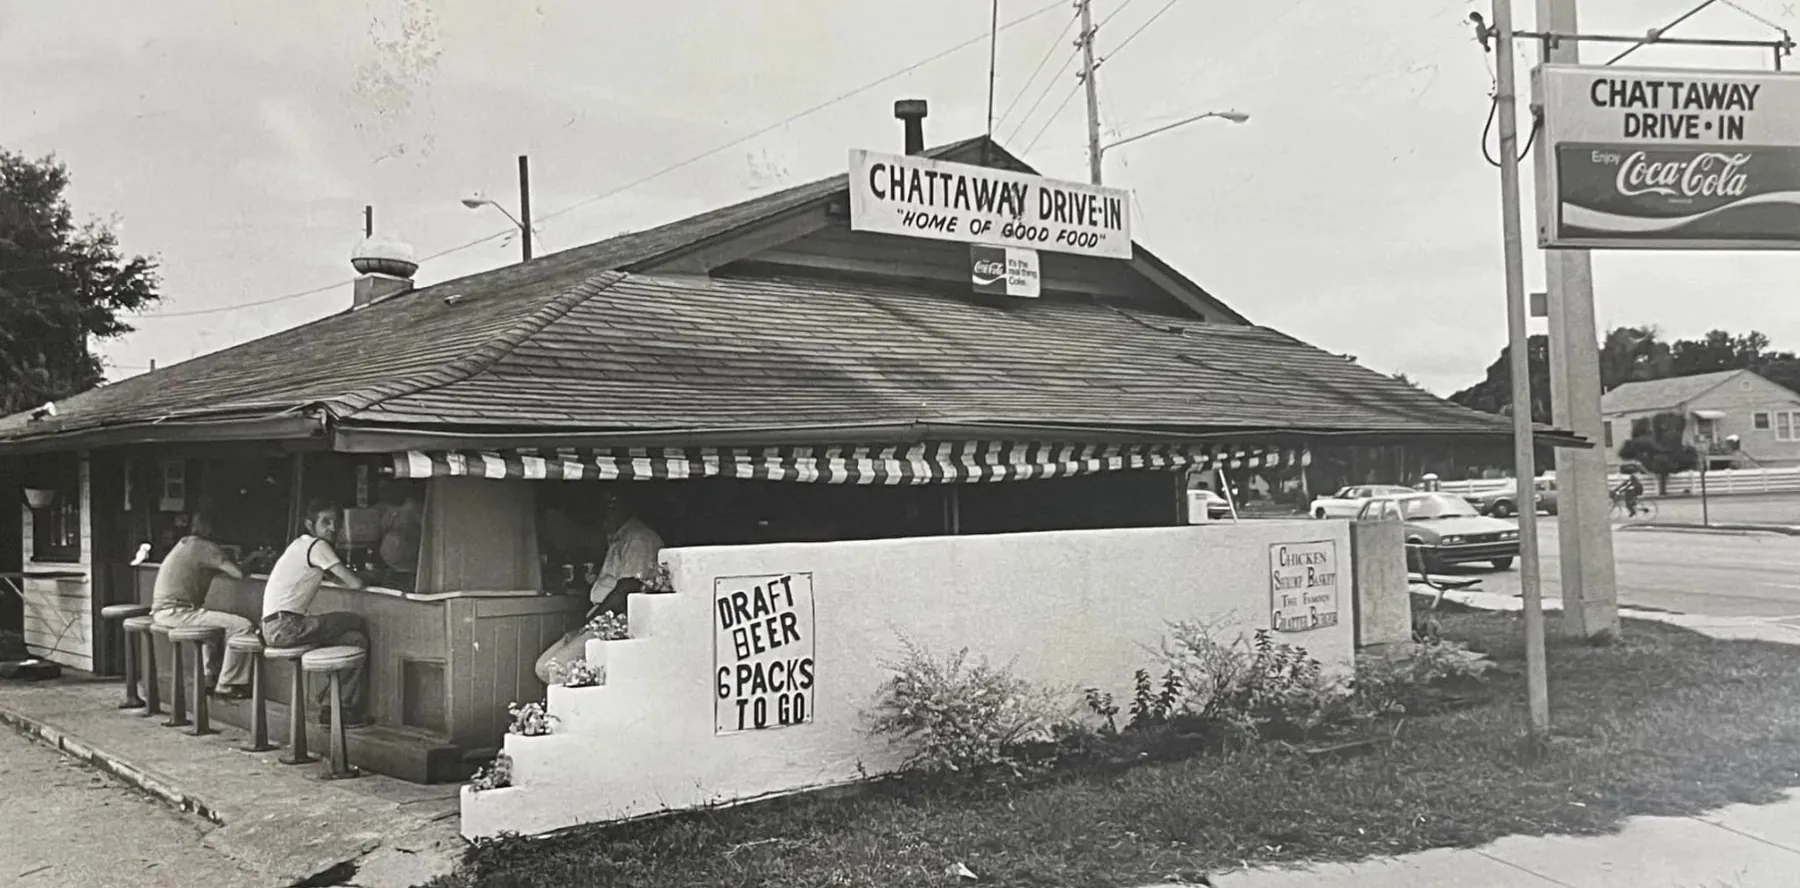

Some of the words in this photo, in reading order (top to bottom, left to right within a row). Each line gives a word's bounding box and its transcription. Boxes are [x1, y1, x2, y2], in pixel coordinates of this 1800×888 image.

[1590, 78, 1761, 111] CHATTAWAY
[1591, 151, 1620, 165] Enjoy
[1616, 151, 1752, 196] Coca-Cola
[869, 162, 1029, 217] CHATTAWAY
[970, 218, 993, 236] OF
[1002, 222, 1050, 243] GOOD
[1280, 546, 1327, 567] CHICKEN
[717, 575, 794, 629] DRAFT
[733, 611, 801, 661] BEER
[718, 666, 731, 699] 6
[736, 657, 814, 697] PACKS
[736, 696, 767, 730] TO
[778, 692, 805, 725] GO
